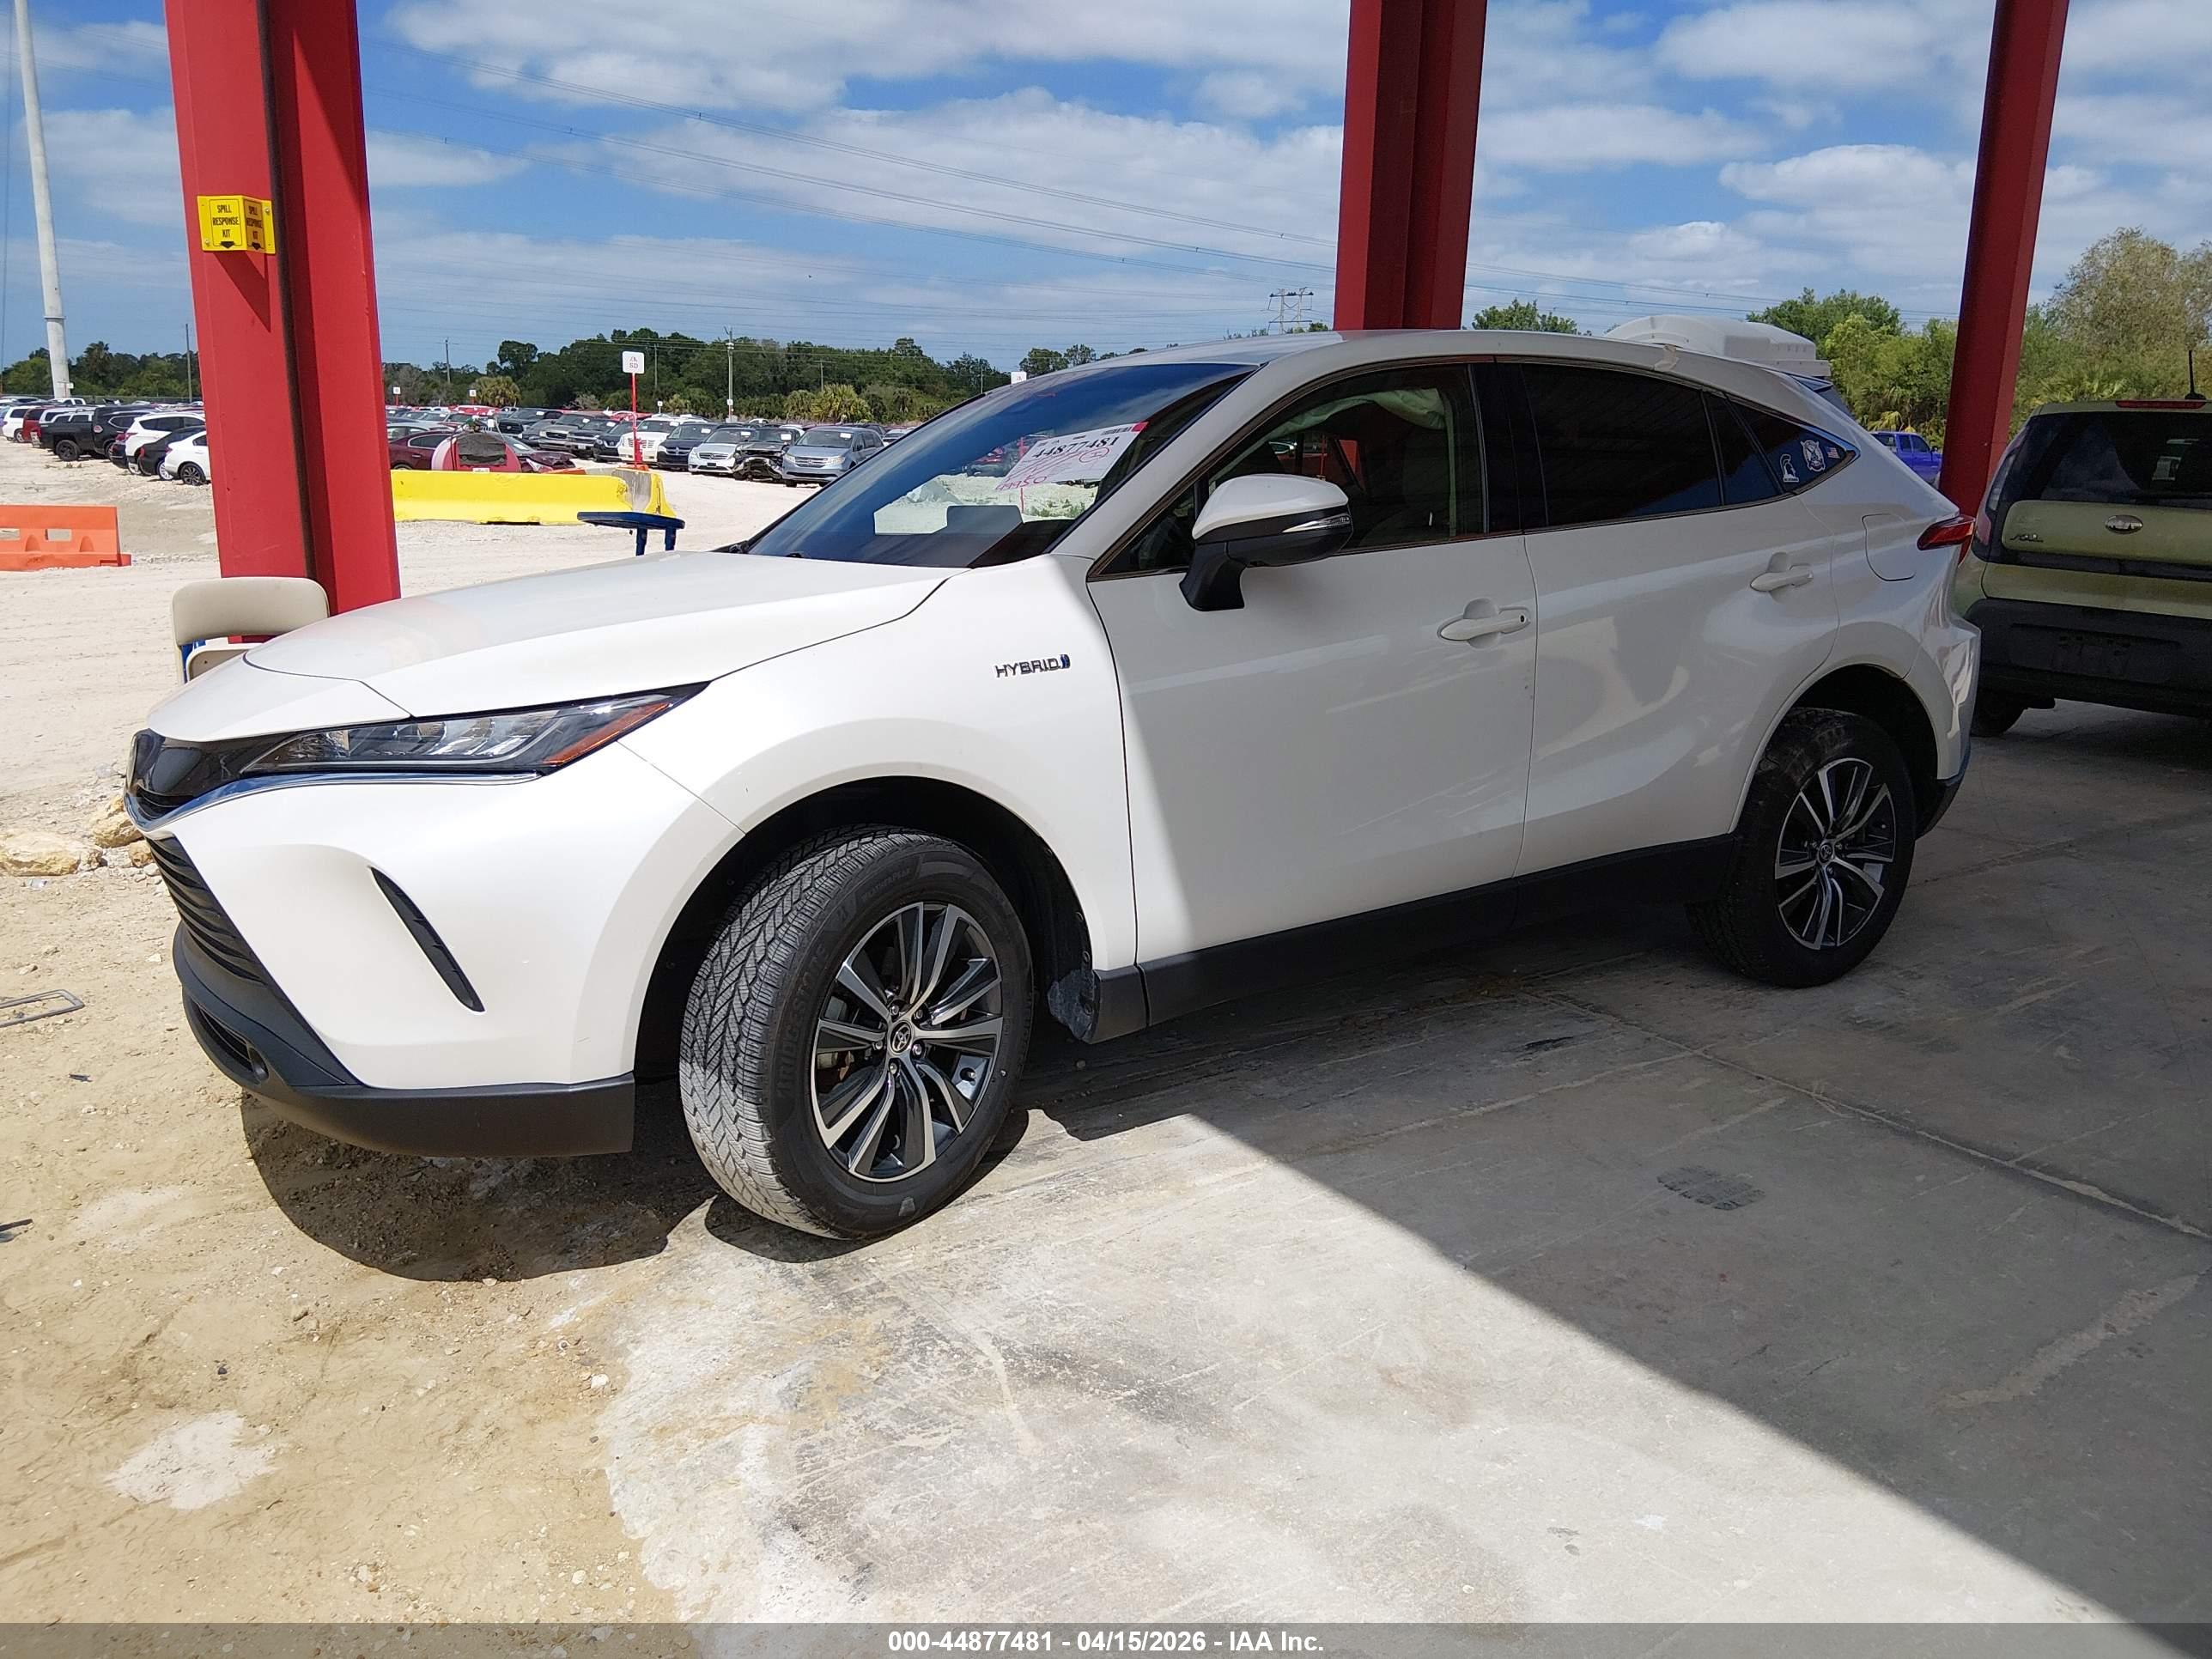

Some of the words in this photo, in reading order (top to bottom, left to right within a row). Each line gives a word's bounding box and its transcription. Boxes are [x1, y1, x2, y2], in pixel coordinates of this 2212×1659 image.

[216, 204, 232, 213] SPILL
[212, 216, 239, 226] RESPONSE
[222, 229, 231, 238] KIT
[1032, 436, 1119, 458] 44877481
[995, 658, 1061, 678] HYBRID
